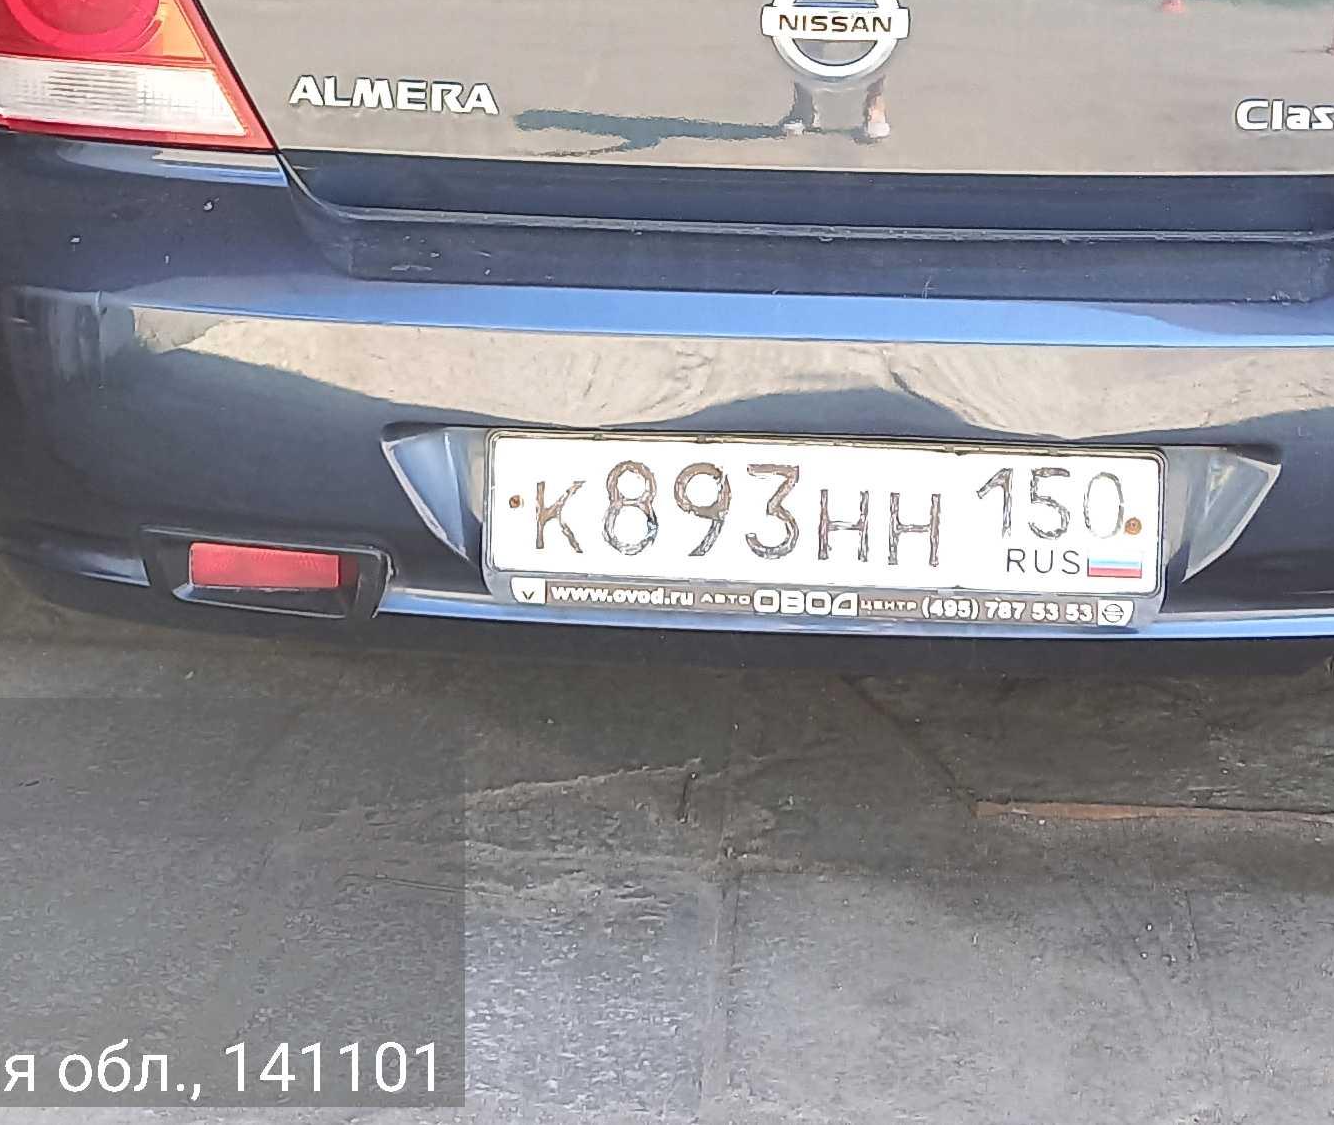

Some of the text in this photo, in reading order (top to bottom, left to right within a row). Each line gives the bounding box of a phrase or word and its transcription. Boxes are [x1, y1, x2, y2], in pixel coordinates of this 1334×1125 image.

[778, 14, 893, 33] NISSAN
[289, 74, 500, 116] ALMERA
[535, 459, 1126, 567] К893НН 150
[1006, 548, 1080, 575] RUS
[550, 585, 695, 606] www.ovod.ru
[921, 596, 980, 620] (495)
[984, 600, 1027, 621] 787
[1031, 602, 1061, 622] 53
[1065, 603, 1093, 623] 53
